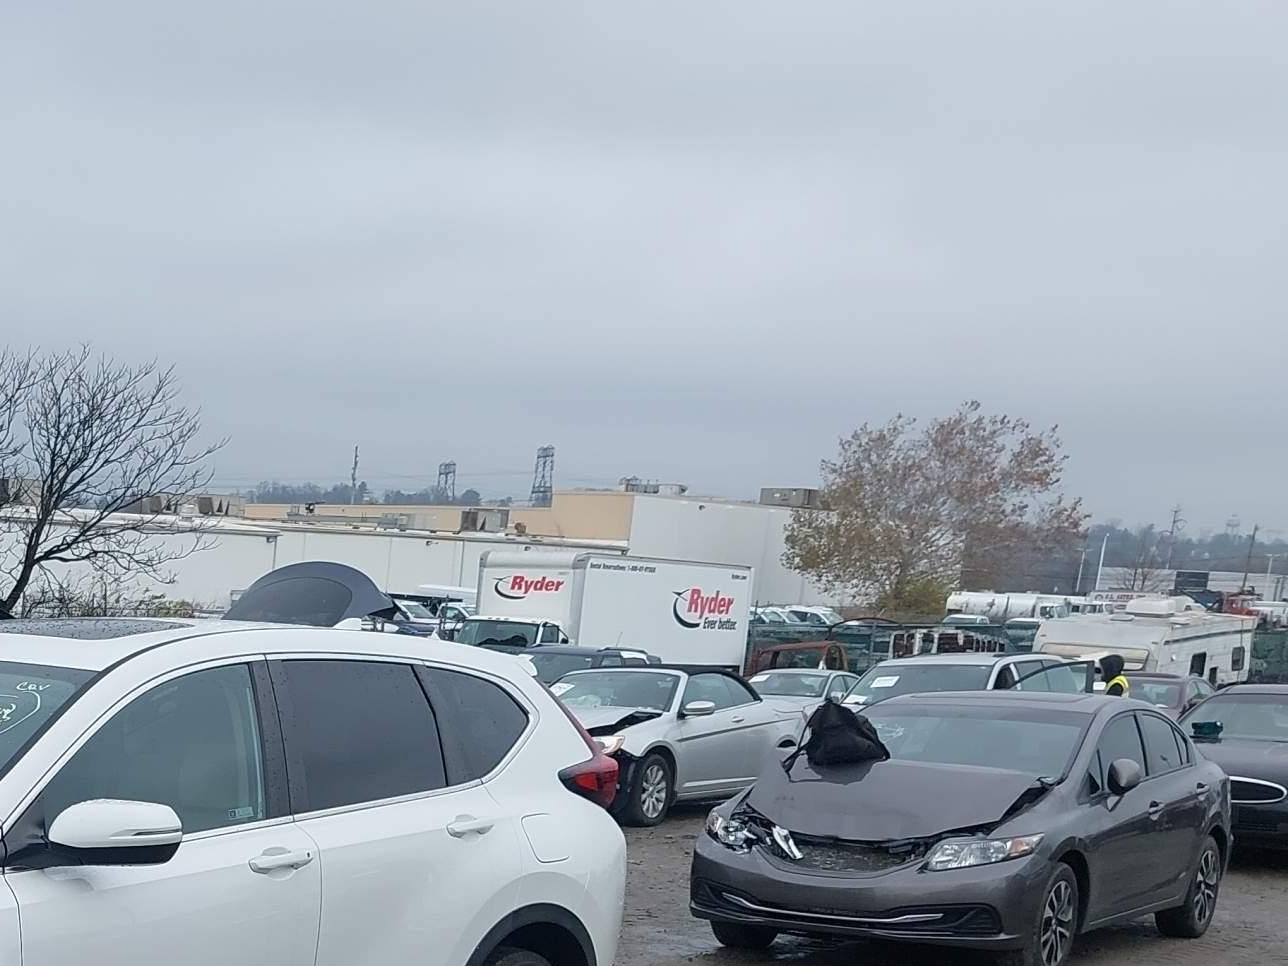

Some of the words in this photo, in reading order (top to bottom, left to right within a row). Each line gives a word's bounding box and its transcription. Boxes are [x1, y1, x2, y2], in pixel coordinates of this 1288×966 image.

[510, 575, 565, 595] Ryder
[687, 588, 735, 620] Ryder
[703, 617, 718, 630] Ever
